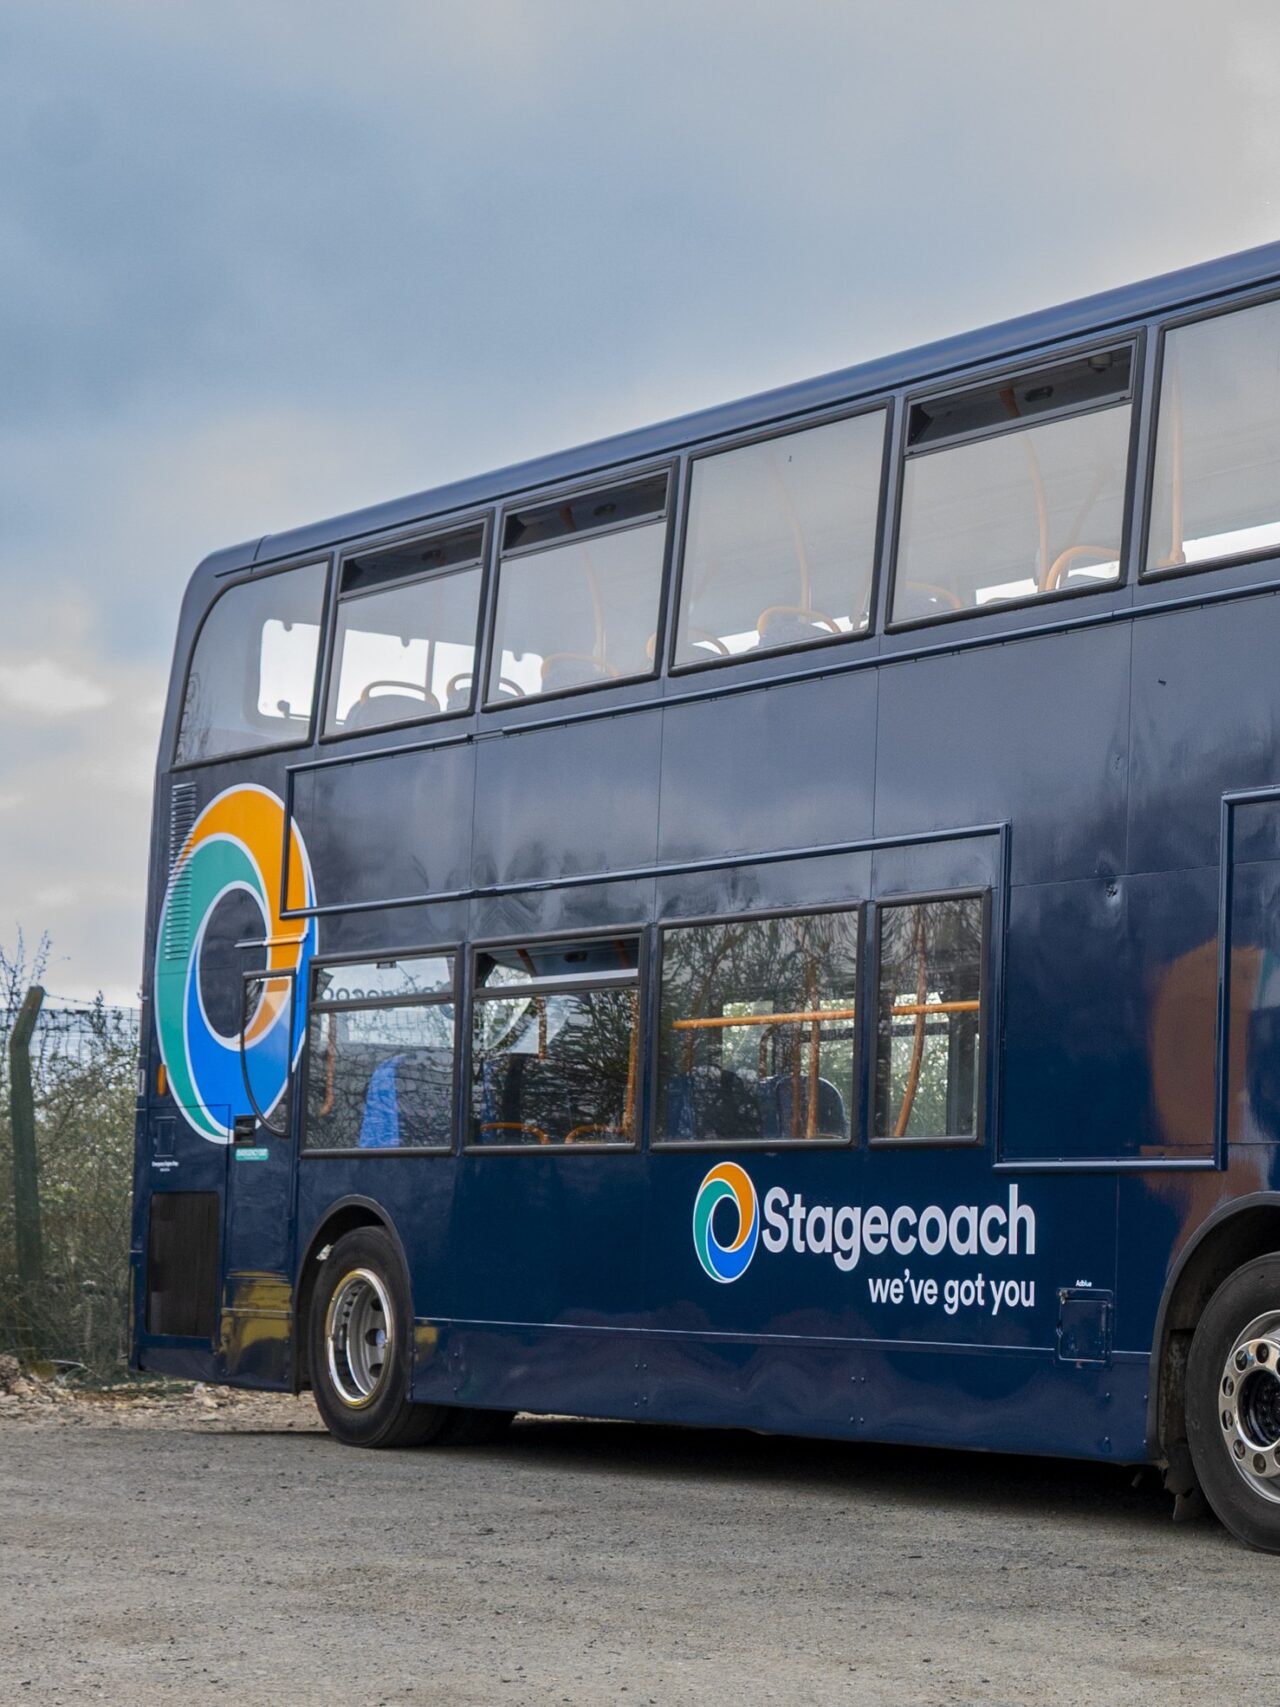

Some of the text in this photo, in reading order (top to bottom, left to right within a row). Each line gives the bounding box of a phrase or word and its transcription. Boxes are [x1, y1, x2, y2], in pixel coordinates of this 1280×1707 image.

[762, 1184, 1036, 1272] Stagecoach
[944, 1273, 985, 1315] got
[990, 1280, 1035, 1316] you
